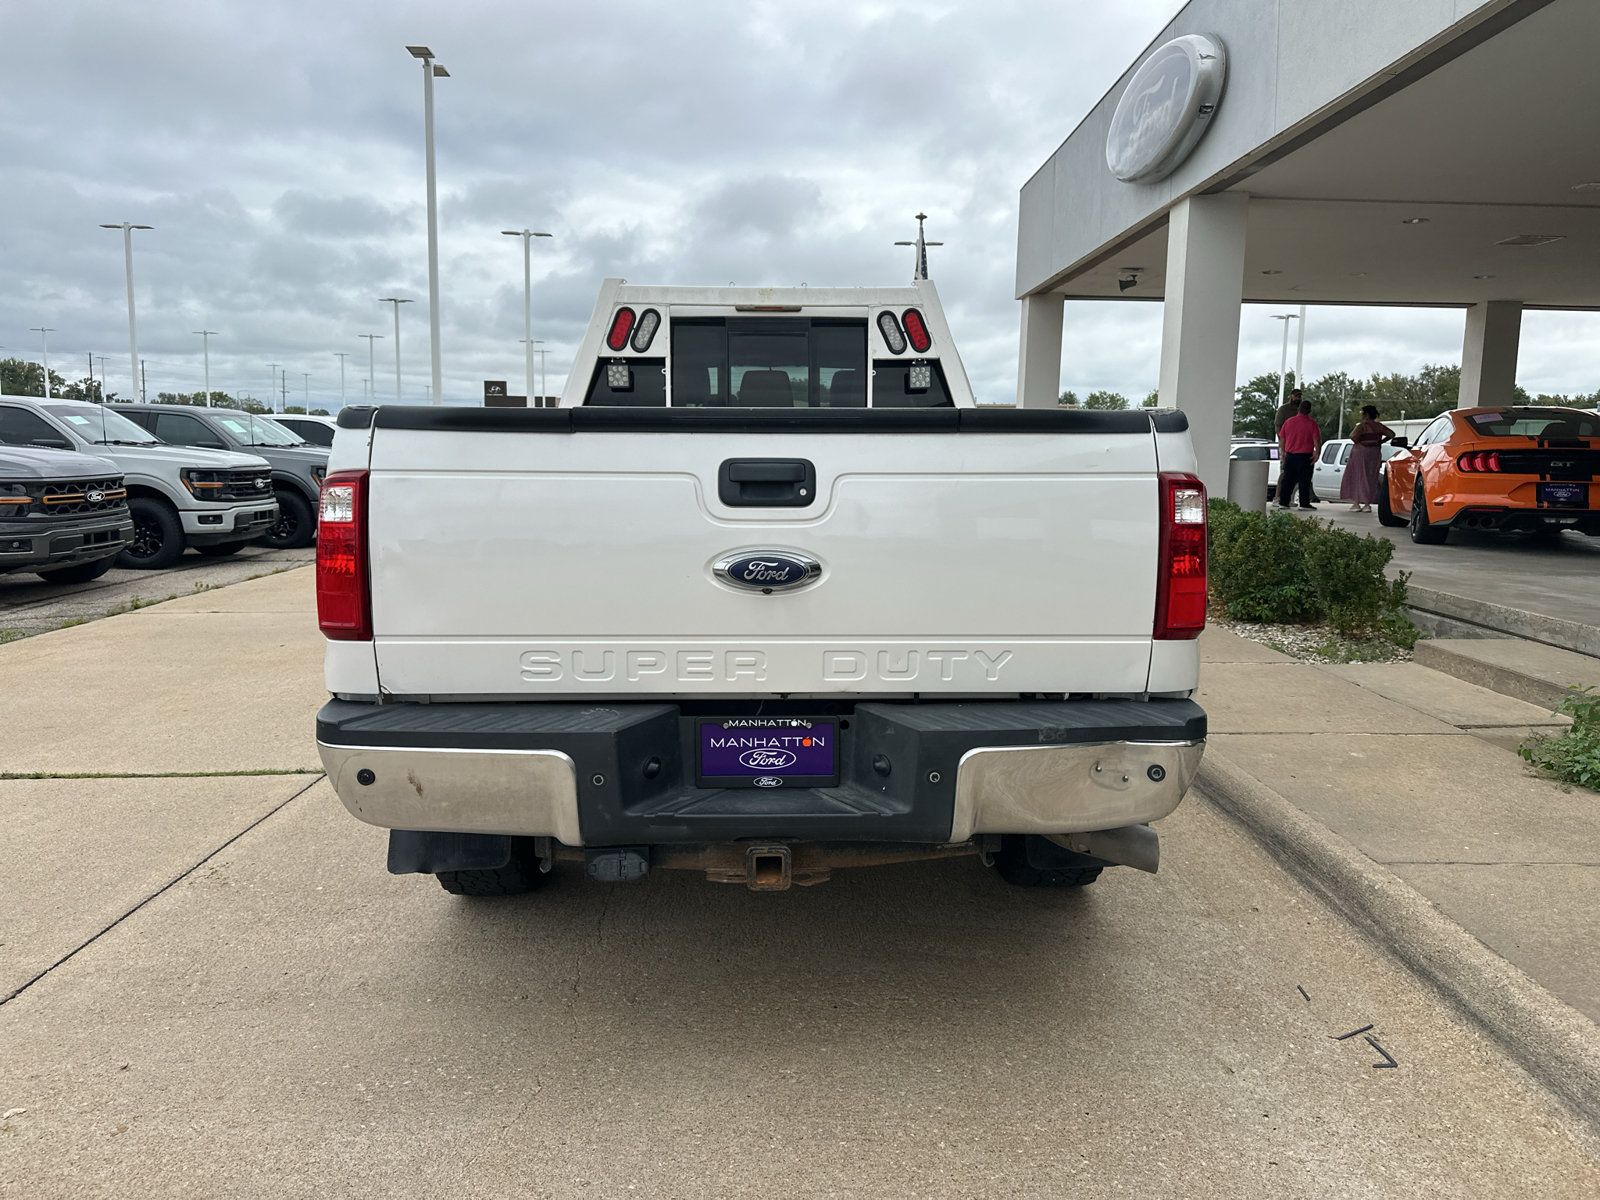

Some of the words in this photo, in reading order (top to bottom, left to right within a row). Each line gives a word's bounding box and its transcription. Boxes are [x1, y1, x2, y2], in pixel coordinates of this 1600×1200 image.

[743, 561, 790, 580] Ford
[519, 650, 767, 682] SUPER
[822, 650, 1014, 682] DUTY
[748, 750, 787, 766] Ford
